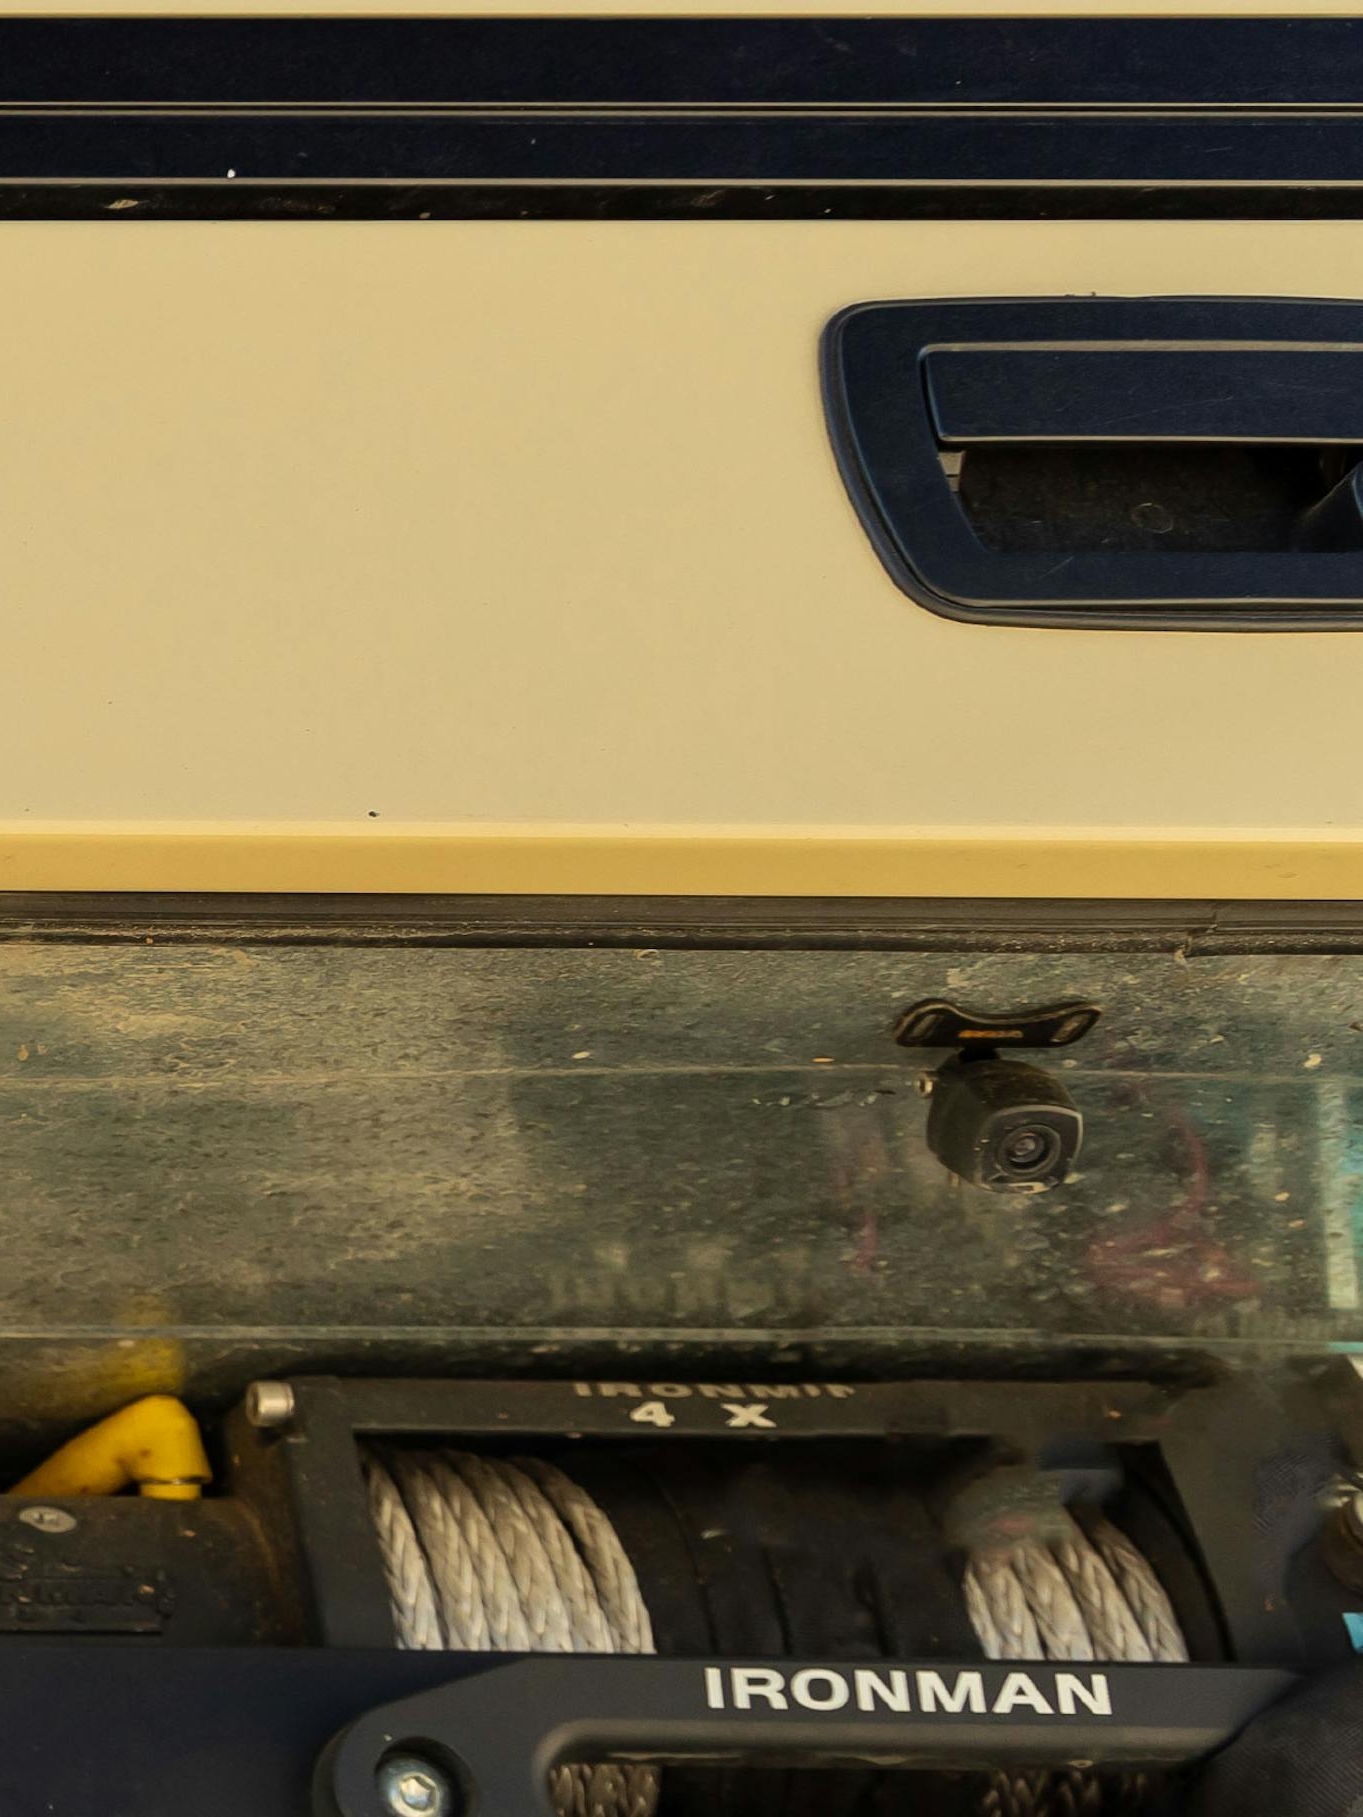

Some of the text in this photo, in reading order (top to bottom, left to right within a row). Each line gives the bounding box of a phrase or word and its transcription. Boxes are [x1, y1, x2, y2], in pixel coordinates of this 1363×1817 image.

[631, 1402, 775, 1427] 4 X
[705, 1667, 1113, 1715] IRONMAN
